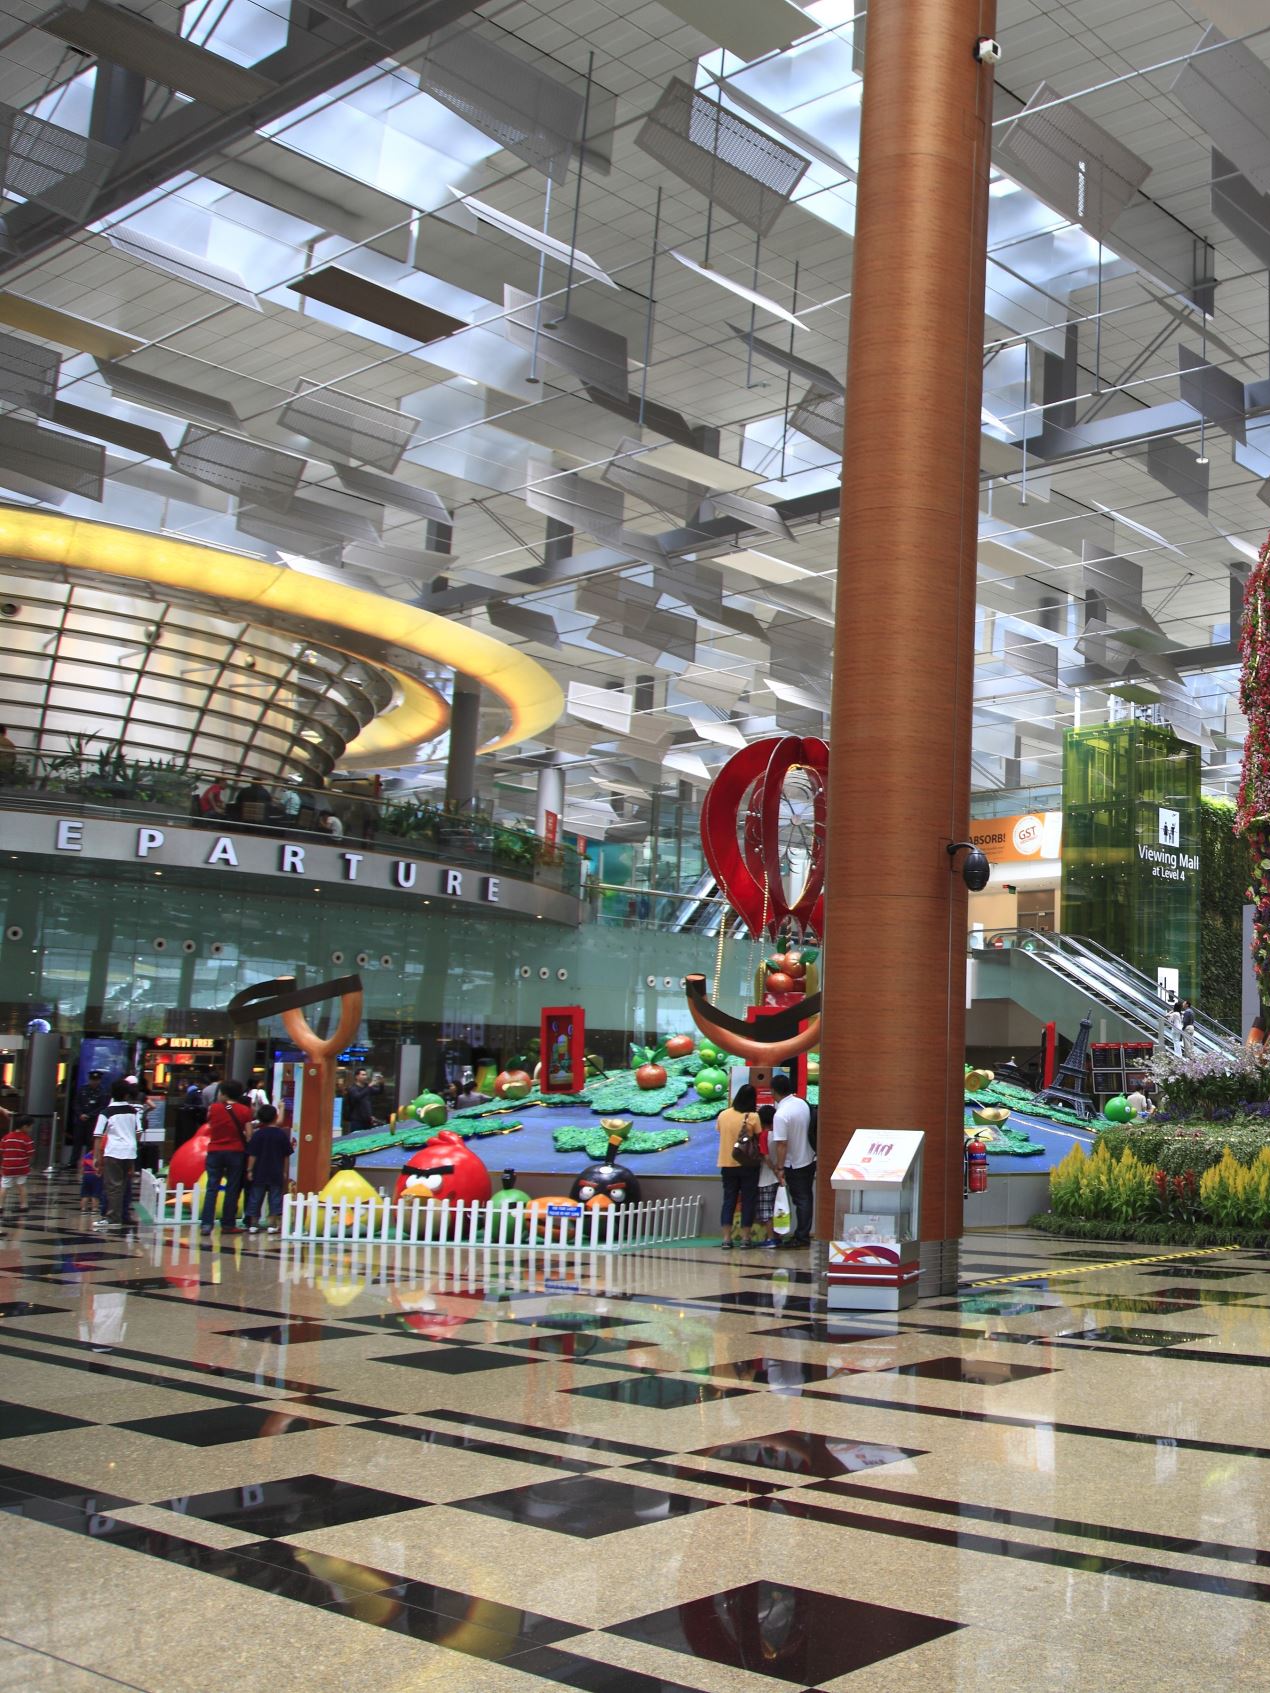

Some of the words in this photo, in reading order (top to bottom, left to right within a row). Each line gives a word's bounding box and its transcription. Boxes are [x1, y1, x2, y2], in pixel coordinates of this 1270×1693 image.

[1018, 826, 1037, 841] GST
[56, 819, 501, 902] EPARTURE
[1138, 844, 1177, 869] Viewing
[1179, 853, 1199, 870] Mall
[1152, 867, 1160, 877] at
[1161, 867, 1179, 880] Level
[1180, 871, 1186, 881] 4
[170, 1037, 191, 1047] DUTY
[192, 1038, 214, 1047] FREE
